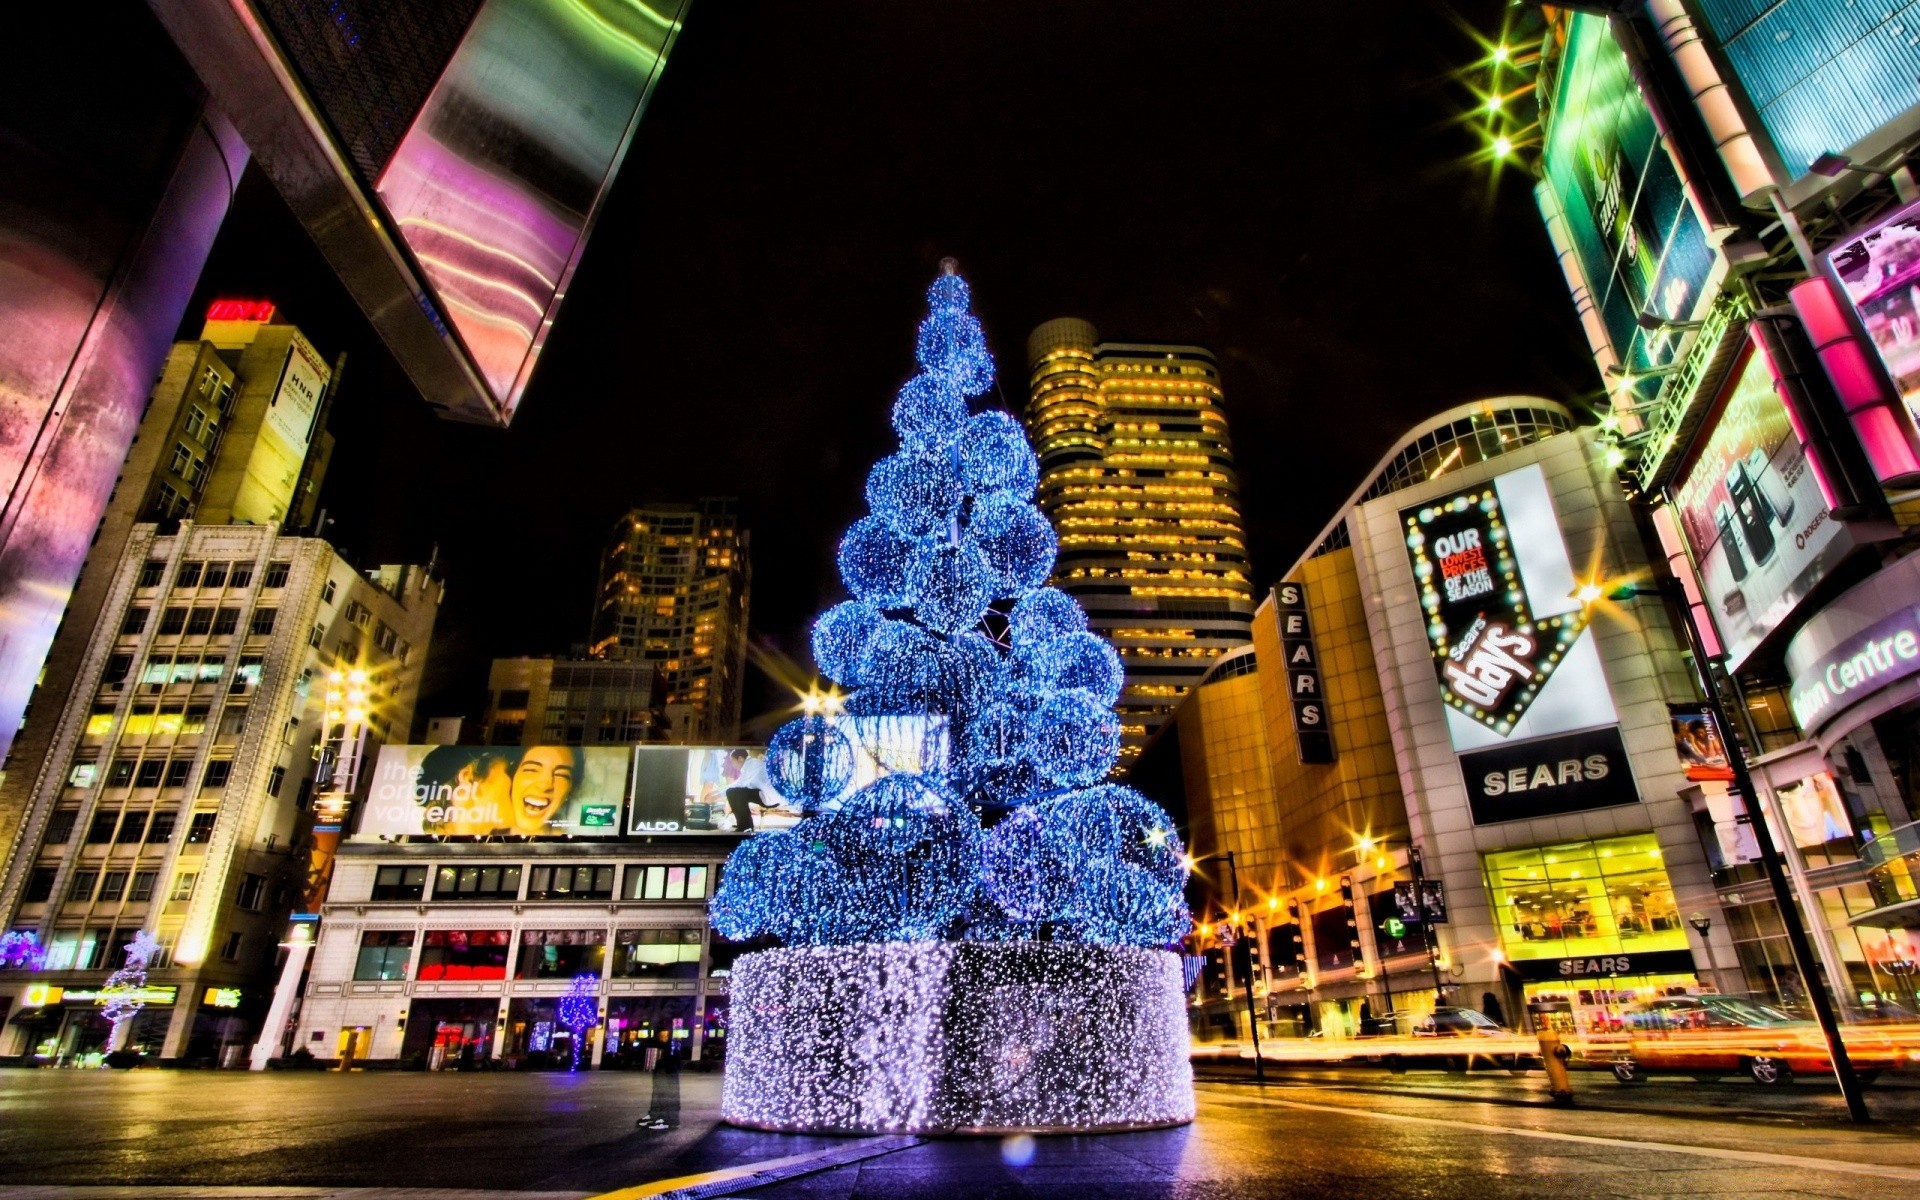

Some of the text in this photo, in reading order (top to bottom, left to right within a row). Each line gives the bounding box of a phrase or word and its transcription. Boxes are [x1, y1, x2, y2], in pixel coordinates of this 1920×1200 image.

[291, 373, 313, 401] HNR
[1803, 508, 1829, 540] ROGERS
[1434, 527, 1482, 559] OUR
[1439, 546, 1483, 570] LOWEST
[1442, 557, 1488, 580] PRICES
[1445, 568, 1490, 591] OF THE
[1446, 579, 1494, 602] SEASON
[1449, 618, 1487, 662] Sears
[1281, 586, 1319, 725] SEARS
[1447, 627, 1532, 706] days
[1826, 630, 1918, 695] Centre
[1701, 706, 1714, 741] DINING
[382, 761, 424, 781] the
[1483, 754, 1610, 796] SEARS
[379, 781, 480, 805] original
[374, 802, 503, 823] voicemail.
[636, 821, 679, 832] ALDO
[1389, 919, 1404, 934] P
[1559, 957, 1630, 975] SEARS
